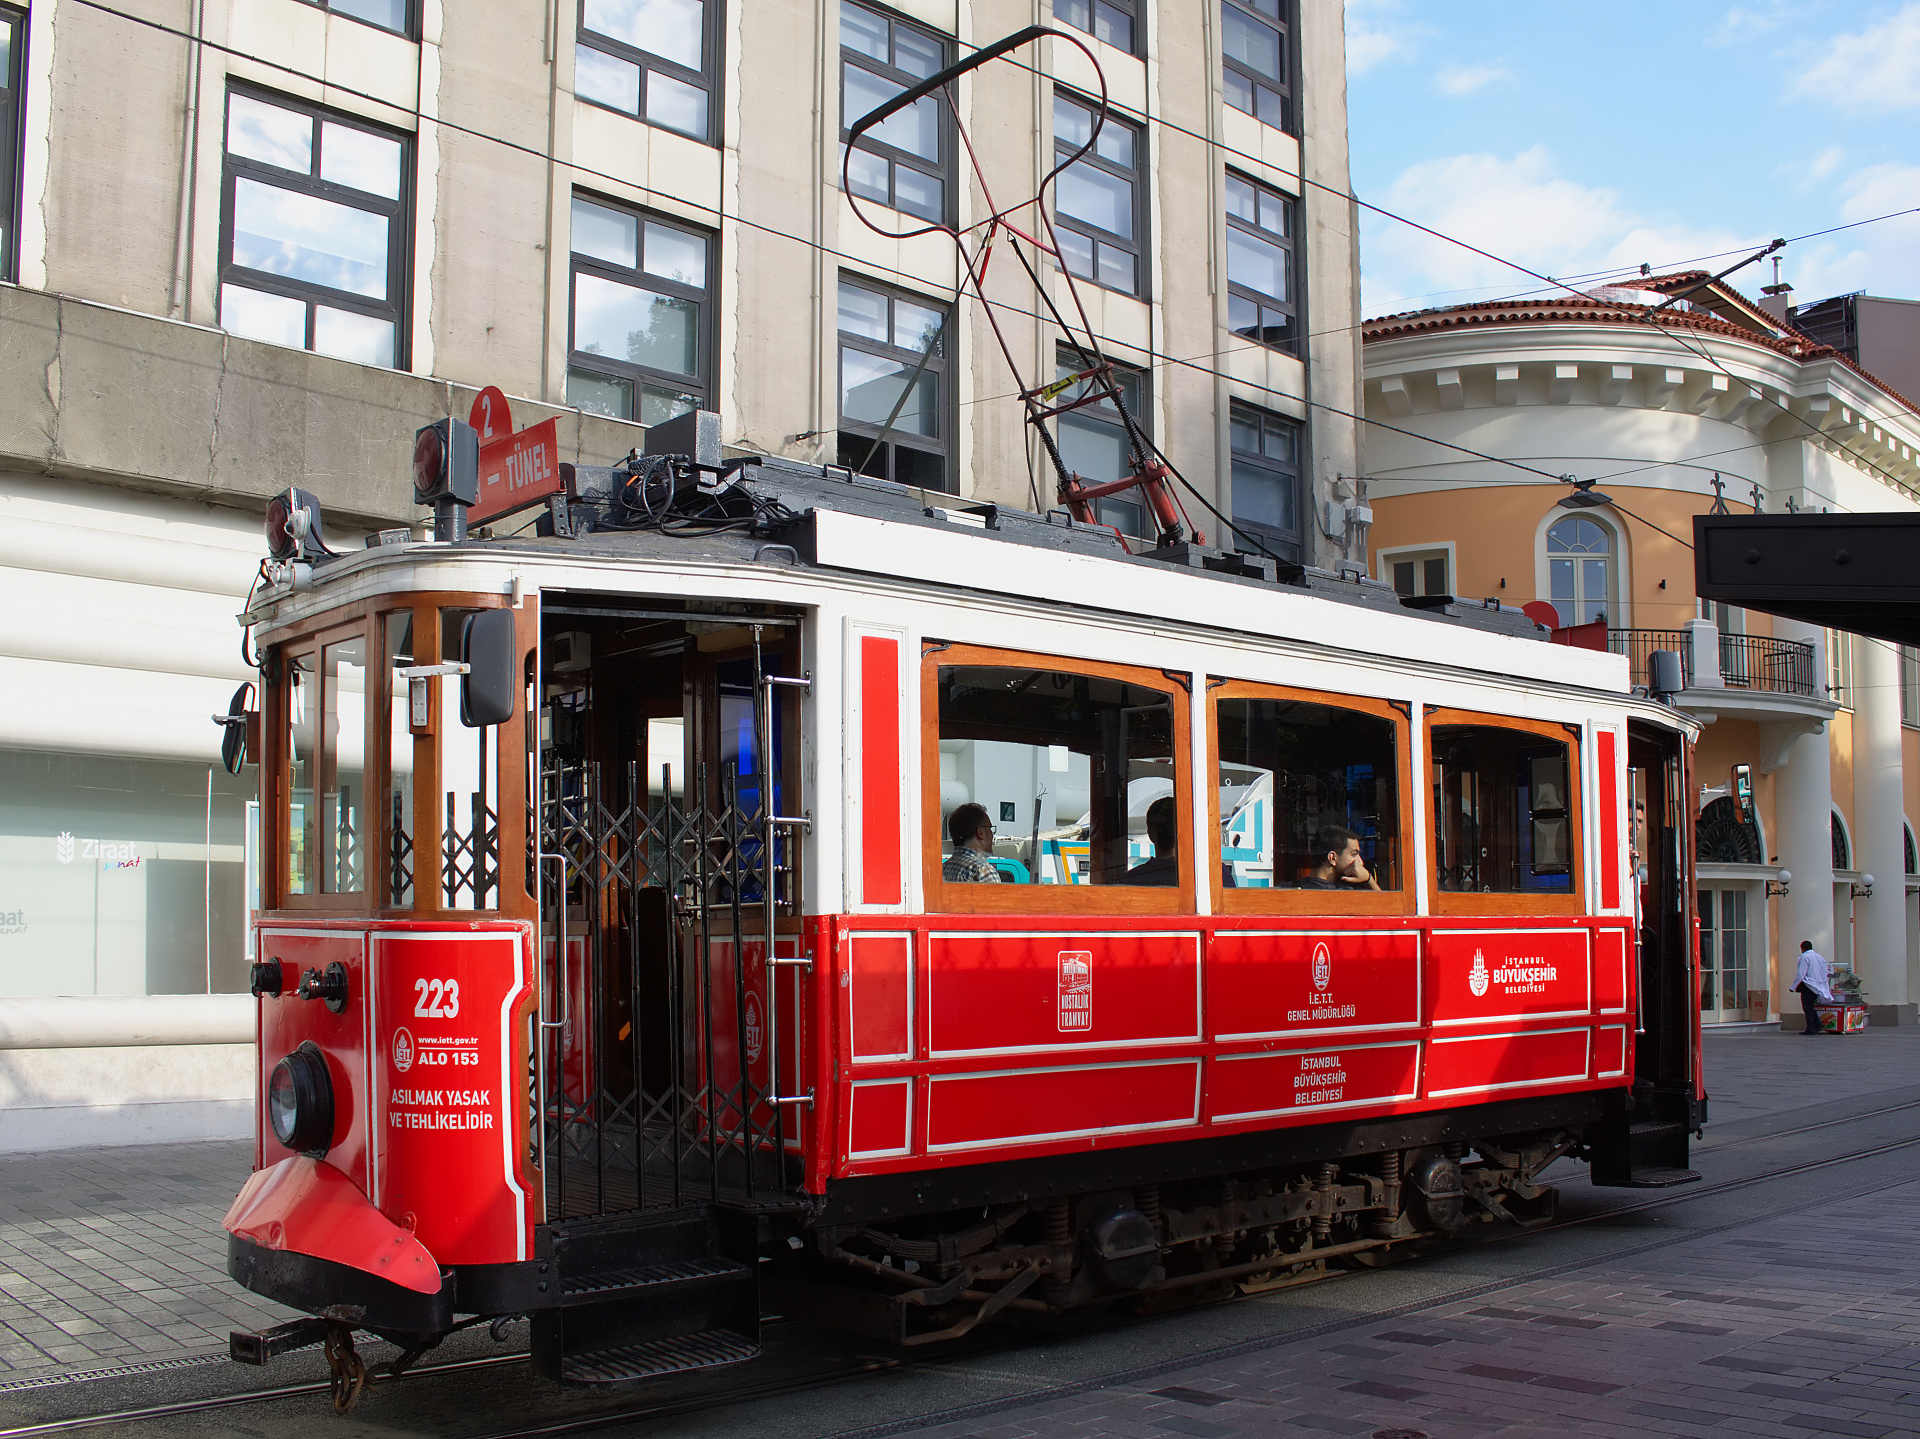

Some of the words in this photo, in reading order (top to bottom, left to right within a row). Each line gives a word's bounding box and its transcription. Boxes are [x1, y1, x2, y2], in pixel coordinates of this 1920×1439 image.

[482, 395, 492, 438] 2
[505, 442, 551, 491] TÜNEL
[81, 839, 137, 859] Ziraat
[103, 856, 141, 871] sanat
[1505, 956, 1545, 965] İSTANBUL
[1493, 963, 1557, 986] BÜYÜKŞEHİR
[1505, 983, 1545, 994] BELEDİYESİ
[414, 978, 459, 1018] 223
[1309, 992, 1334, 1005] İ.E.T.T.
[1061, 1011, 1089, 1027] TRAMVAY
[1287, 1009, 1311, 1021] GENEL
[1312, 1004, 1356, 1020] MÜDÜRLÜĞÜ
[418, 1036, 479, 1045] www.iett.gov.tr
[746, 1025, 760, 1045] ETT
[418, 1052, 448, 1065] ALO
[452, 1052, 479, 1065] 153
[1301, 1056, 1341, 1070] İSTANBUL
[1294, 1070, 1347, 1088] BÜYÜKŞEHİR
[391, 1088, 443, 1106] ASILMAK
[446, 1090, 490, 1106] YASAK
[1295, 1086, 1343, 1105] BELEDİYESİ
[390, 1111, 403, 1128] VE
[405, 1111, 493, 1130] TEHLİKELİDİR
